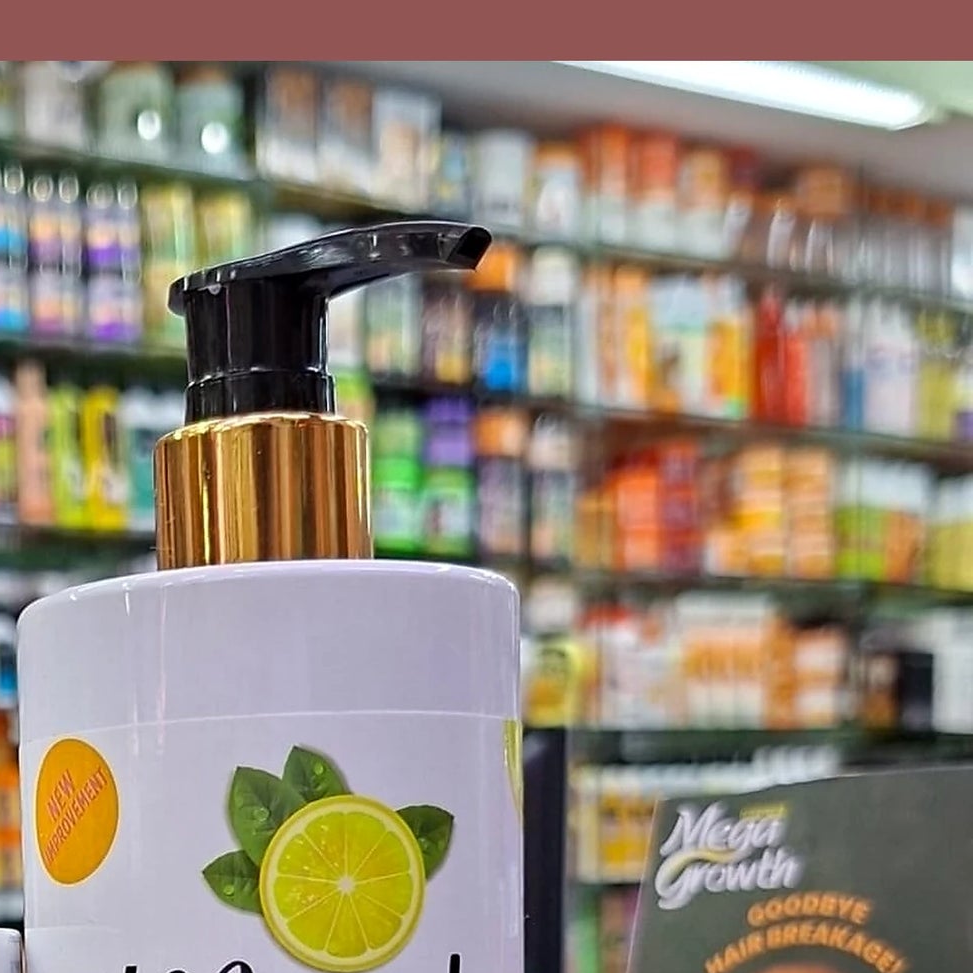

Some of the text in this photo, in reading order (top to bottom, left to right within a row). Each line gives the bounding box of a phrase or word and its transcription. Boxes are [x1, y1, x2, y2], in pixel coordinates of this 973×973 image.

[43, 766, 110, 867] IMPROVEMENT
[660, 801, 785, 858] Mega
[654, 847, 803, 910] Growth
[747, 891, 872, 927] GOODBYE
